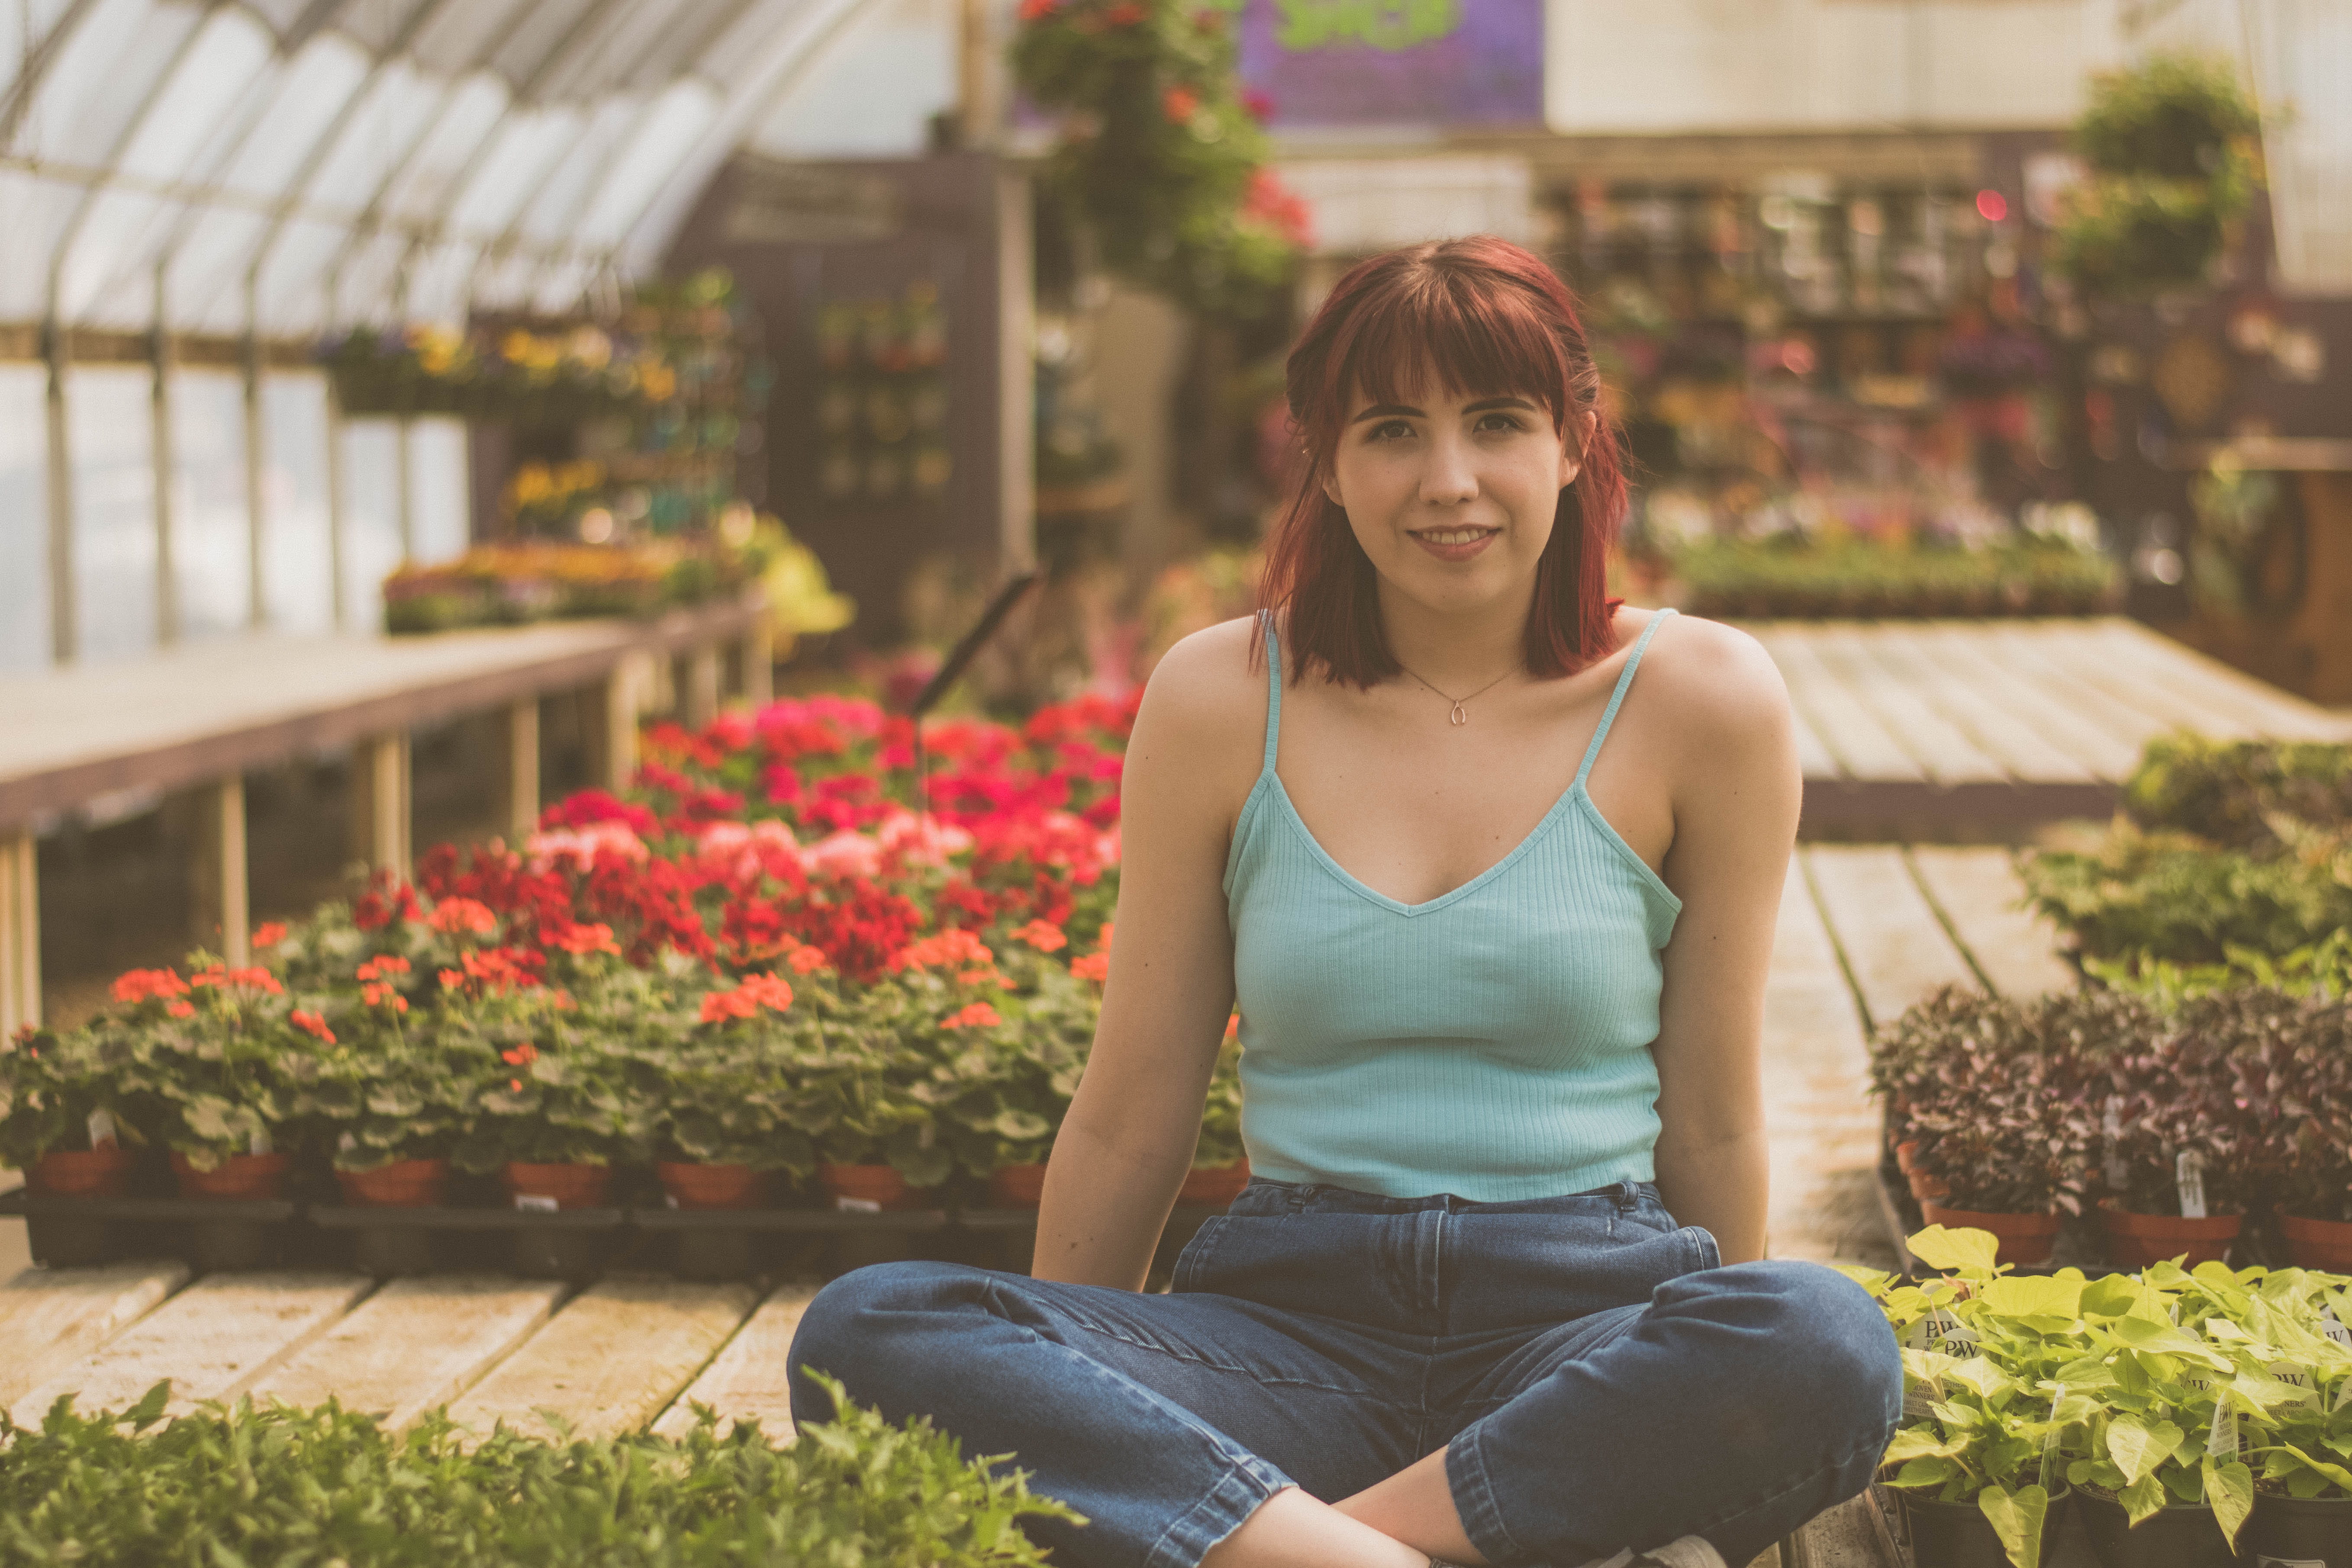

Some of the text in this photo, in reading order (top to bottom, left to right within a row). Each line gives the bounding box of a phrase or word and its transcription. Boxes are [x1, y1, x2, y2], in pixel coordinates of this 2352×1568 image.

[1945, 1340, 1981, 1358] PW
[1914, 1384, 1932, 1393] OVEN
[1909, 1391, 1934, 1401] WINNERS
[1904, 1405, 1929, 1415] WEETHEART
[2219, 1401, 2234, 1423] PW
